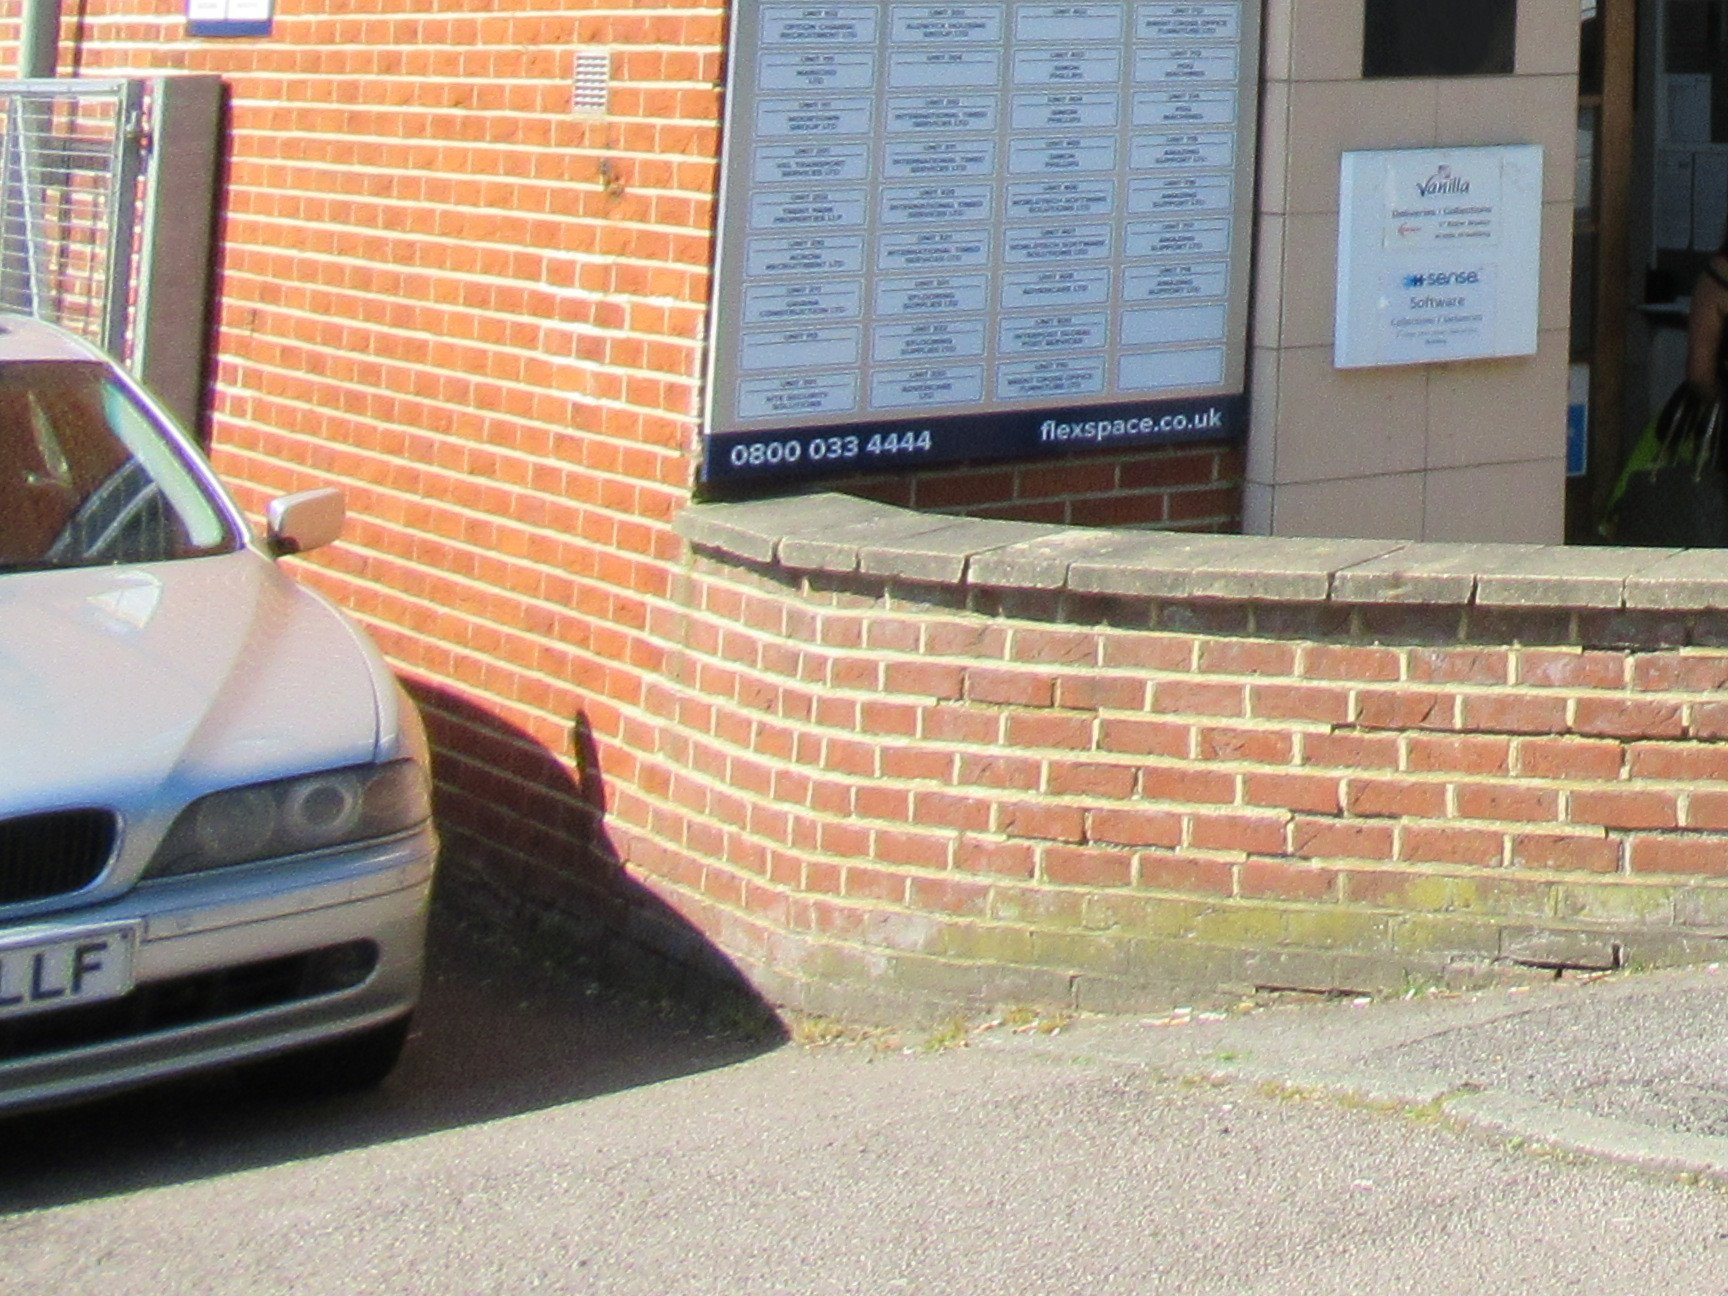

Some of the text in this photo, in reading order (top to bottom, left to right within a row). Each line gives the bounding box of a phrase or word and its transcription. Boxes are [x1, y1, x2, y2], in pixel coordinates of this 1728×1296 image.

[1416, 173, 1471, 197] Vanilla
[1040, 408, 1222, 442] flexspace.co.uk
[731, 430, 932, 466] 0800 033 4444
